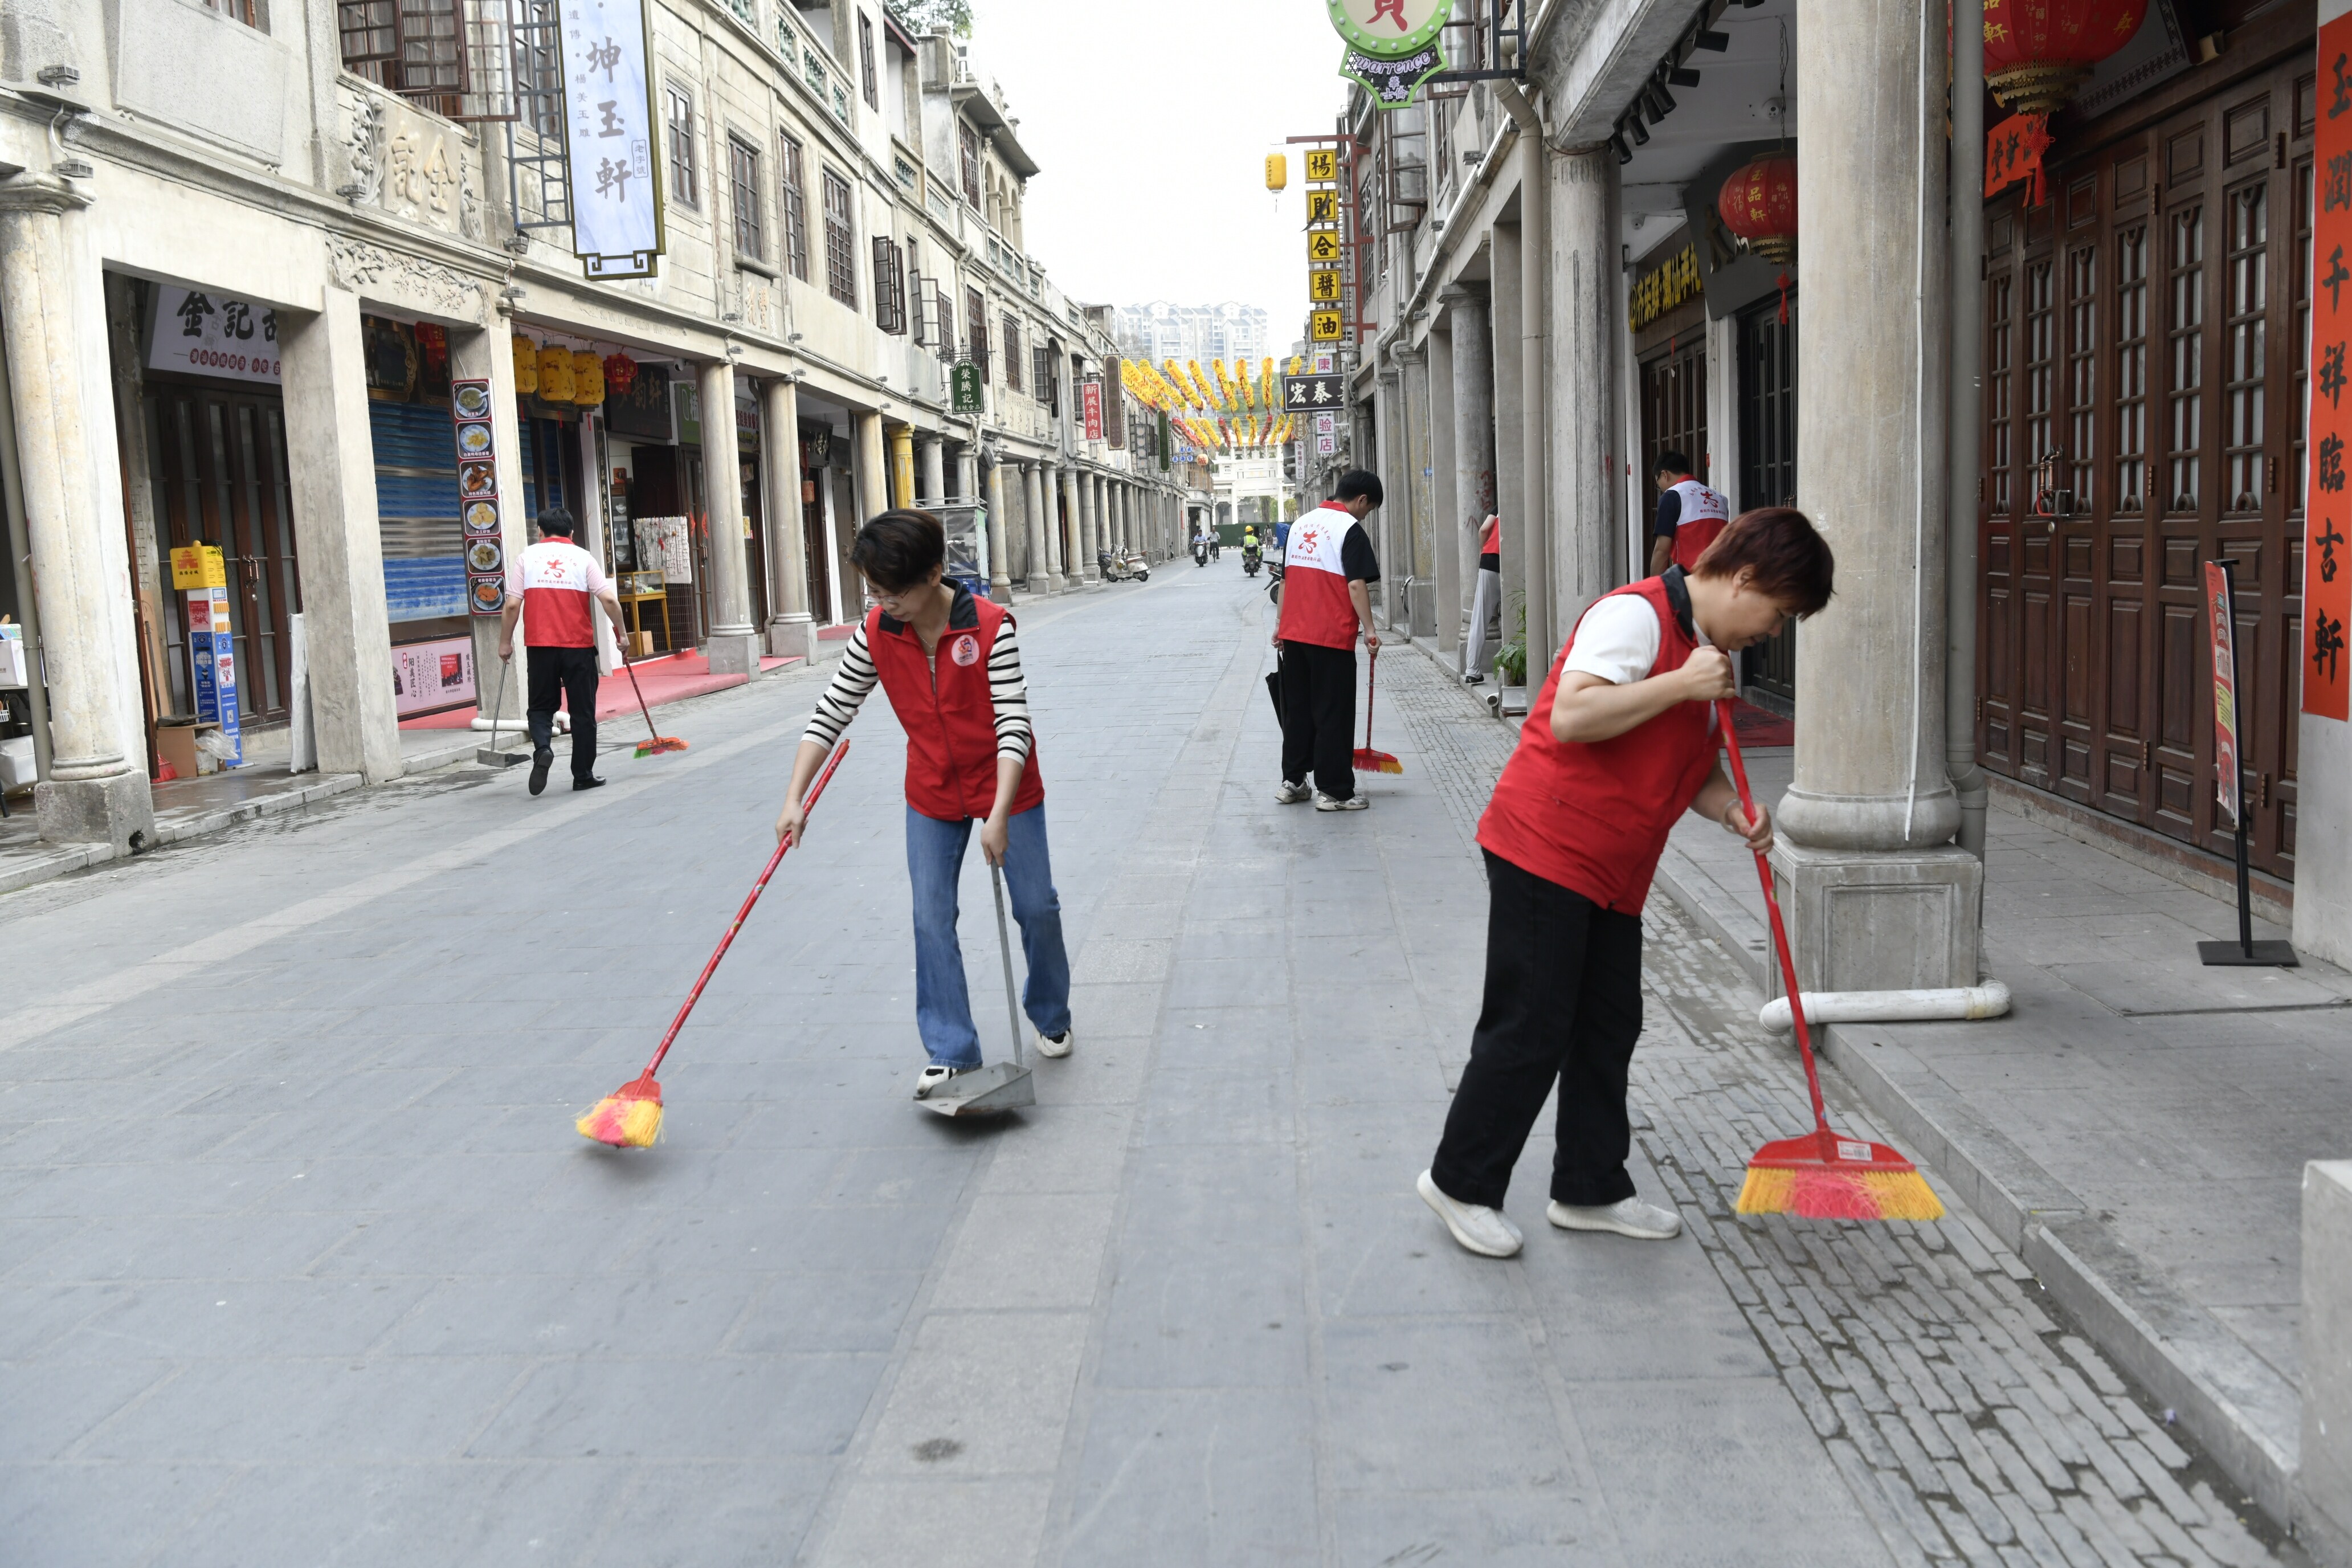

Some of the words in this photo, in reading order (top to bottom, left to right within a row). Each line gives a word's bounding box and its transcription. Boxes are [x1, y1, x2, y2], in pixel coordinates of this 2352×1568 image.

[1356, 52, 1431, 75] warrence
[634, 145, 647, 175] 老字號
[1318, 358, 1330, 370] 康
[961, 368, 973, 403] 榮騰記
[1085, 385, 1099, 439] 新展牛肉店
[1319, 418, 1332, 451] 验店
